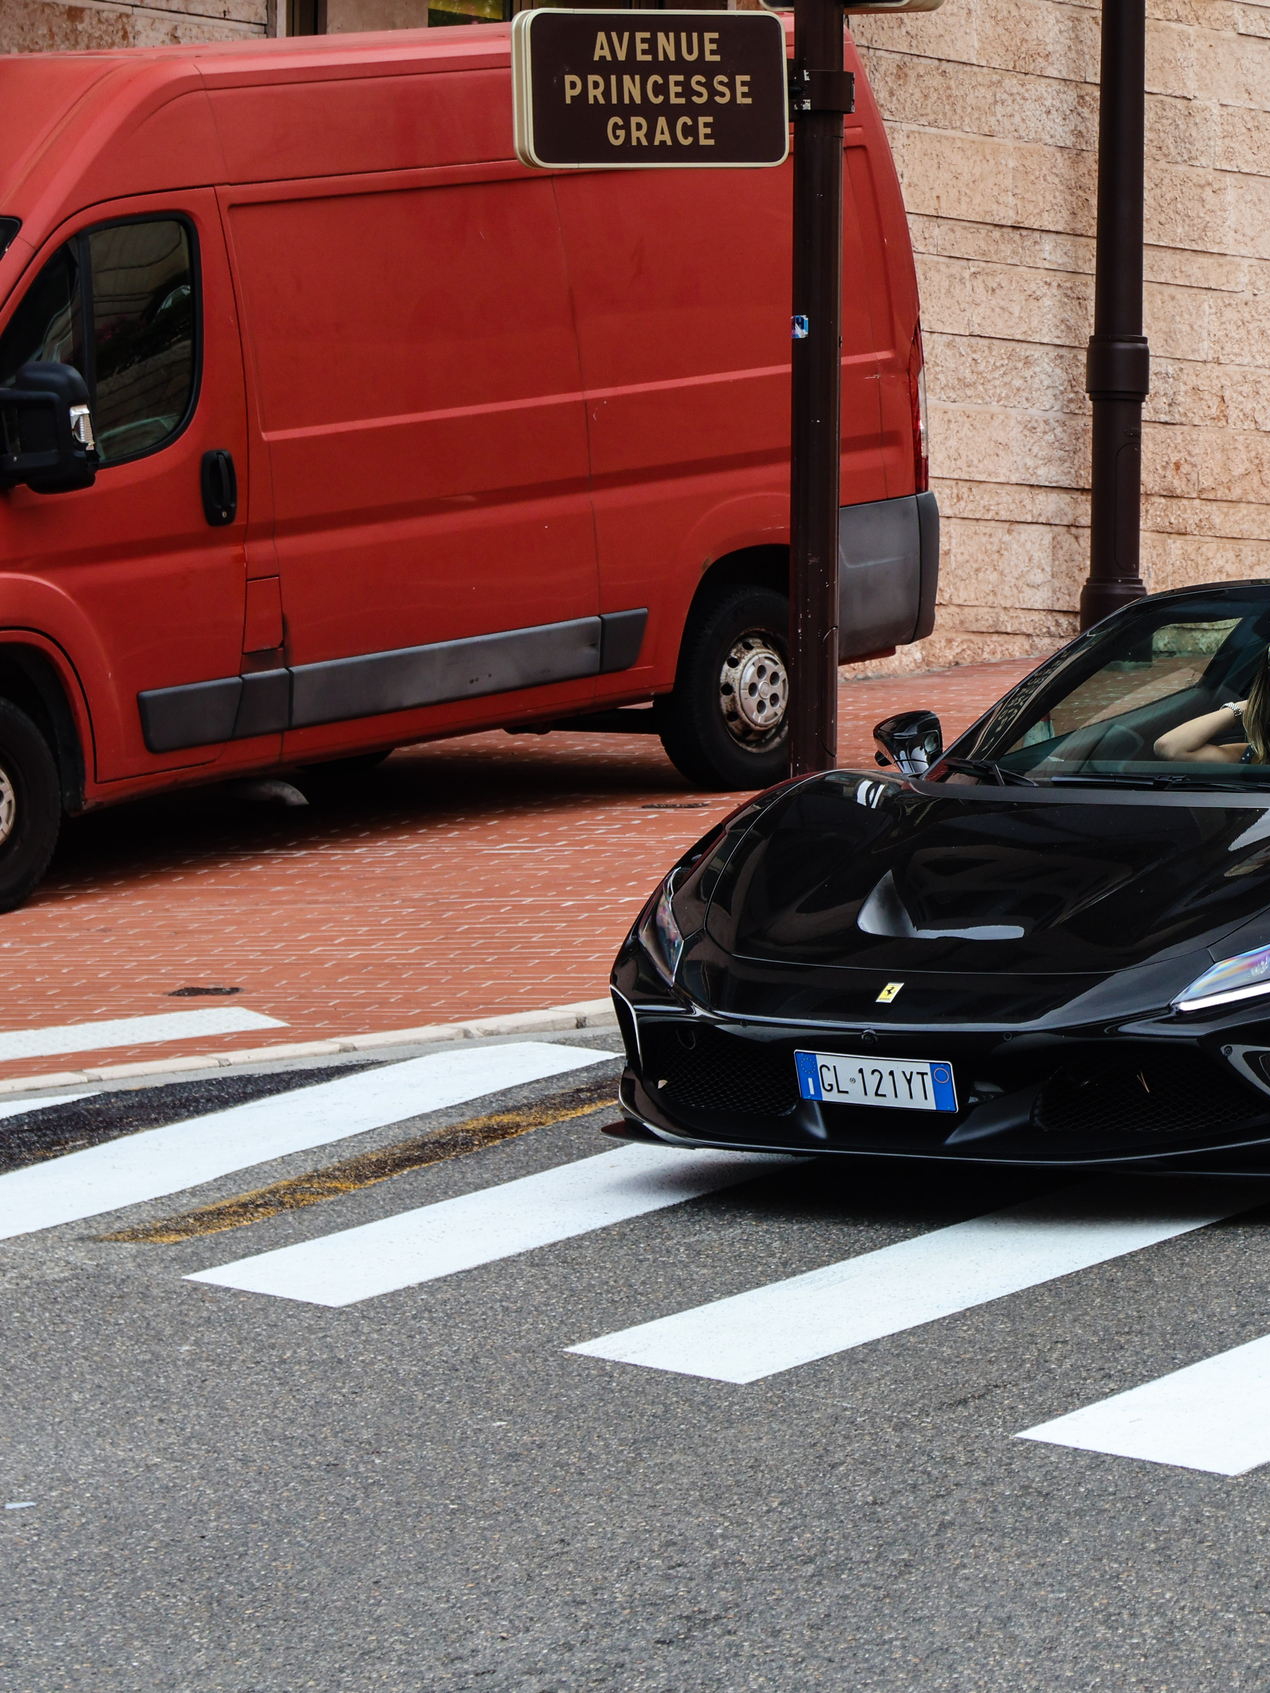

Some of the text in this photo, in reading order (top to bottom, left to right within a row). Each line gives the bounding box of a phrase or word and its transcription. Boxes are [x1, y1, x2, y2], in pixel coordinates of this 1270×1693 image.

[593, 31, 721, 61] AVENUE
[564, 74, 752, 104] PRINCESSE
[606, 116, 715, 146] GRACE
